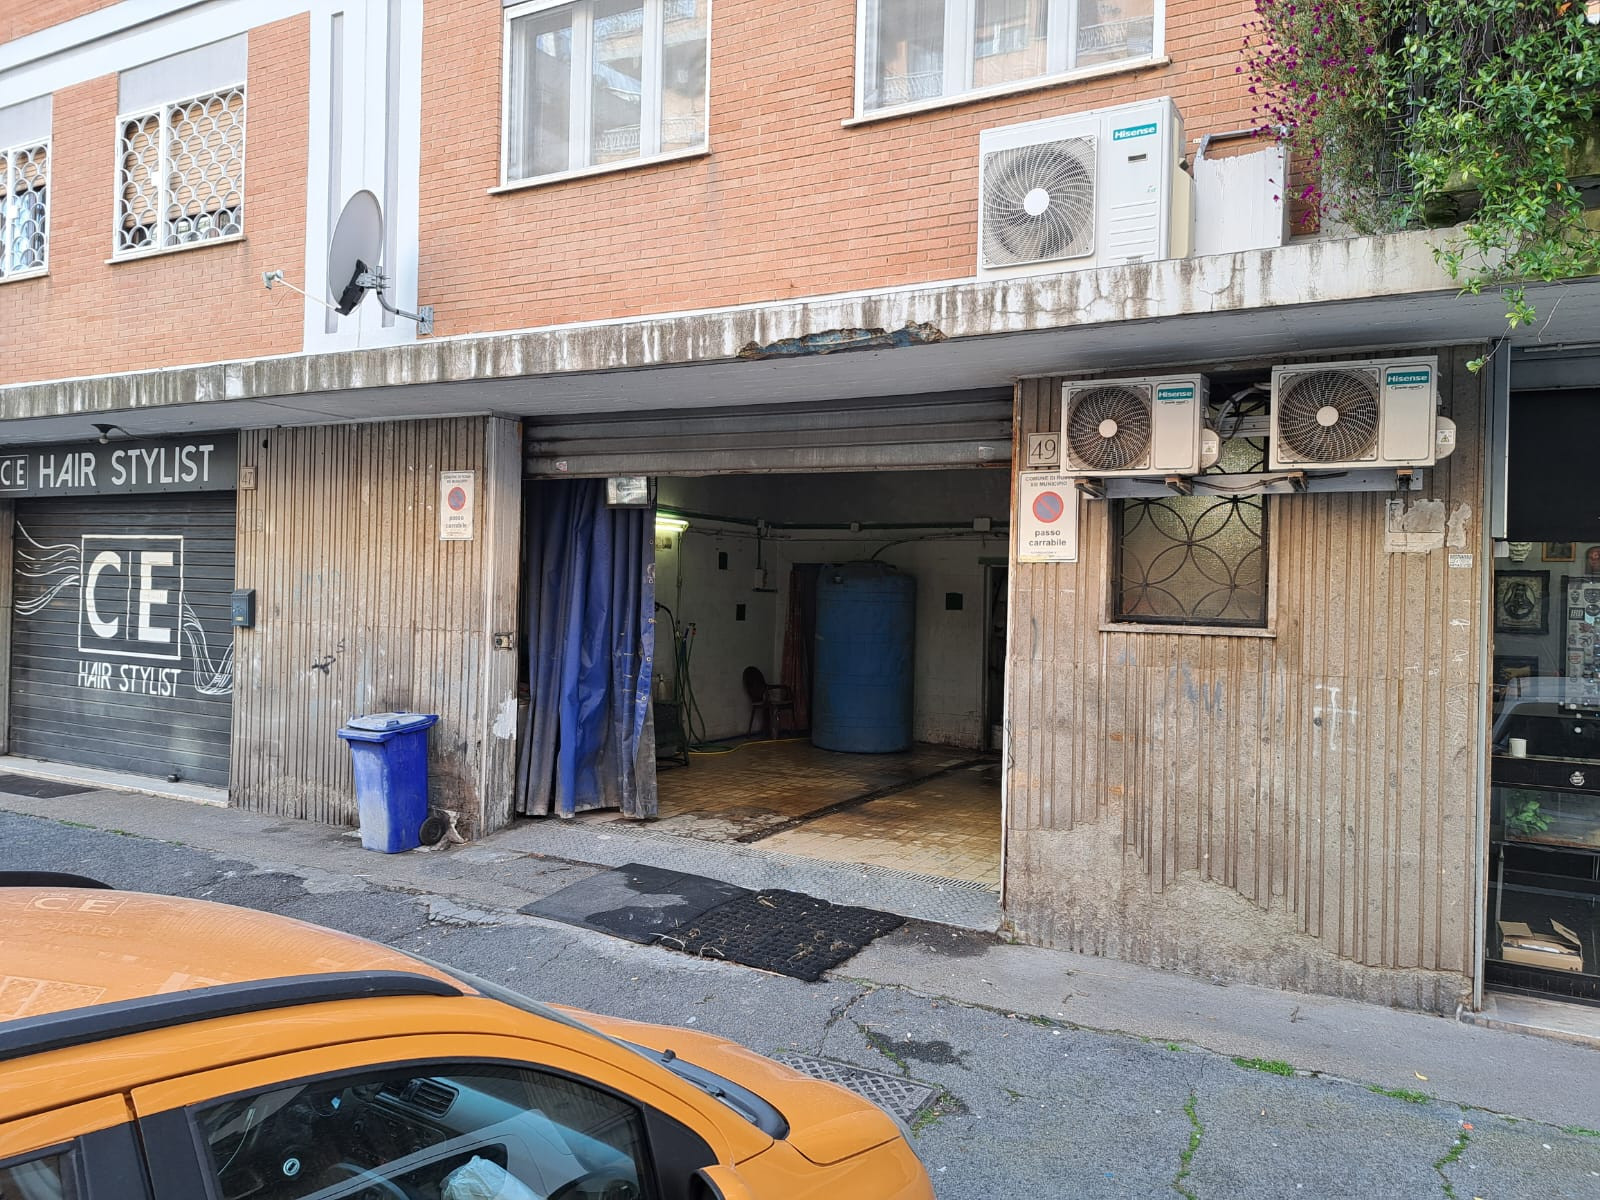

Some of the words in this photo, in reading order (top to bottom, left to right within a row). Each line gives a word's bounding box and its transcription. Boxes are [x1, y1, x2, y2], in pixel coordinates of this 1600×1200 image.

[1115, 127, 1155, 139] Hisense
[1387, 375, 1428, 383] Hisense
[1031, 439, 1056, 460] 49
[0, 459, 25, 486] CE
[39, 452, 97, 489] HAIR
[111, 445, 215, 485] STYLIST
[241, 471, 253, 485] 47
[1034, 529, 1061, 538] passo
[1028, 538, 1067, 547] carrabile
[85, 551, 174, 643] CE
[78, 660, 112, 690] HAIR
[119, 664, 182, 697] STYLIST
